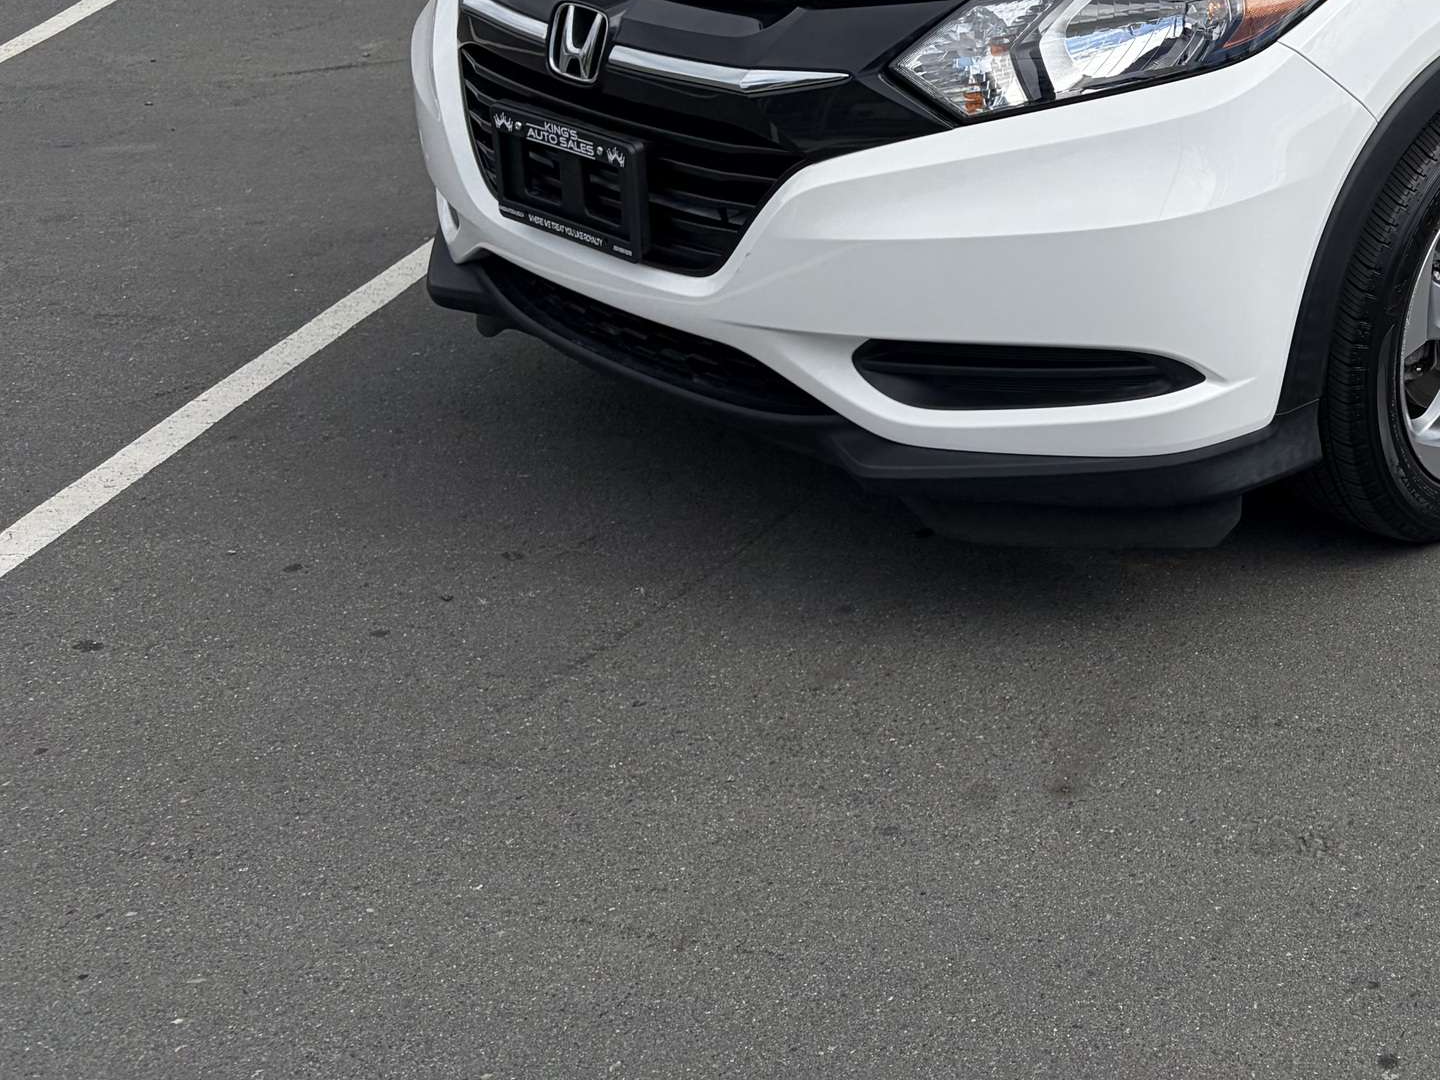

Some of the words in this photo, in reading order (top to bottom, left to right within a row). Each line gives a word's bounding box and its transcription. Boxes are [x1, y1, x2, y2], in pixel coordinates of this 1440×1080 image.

[527, 127, 558, 145] AUTO
[559, 137, 595, 156] SALES
[543, 122, 579, 141] KING'S
